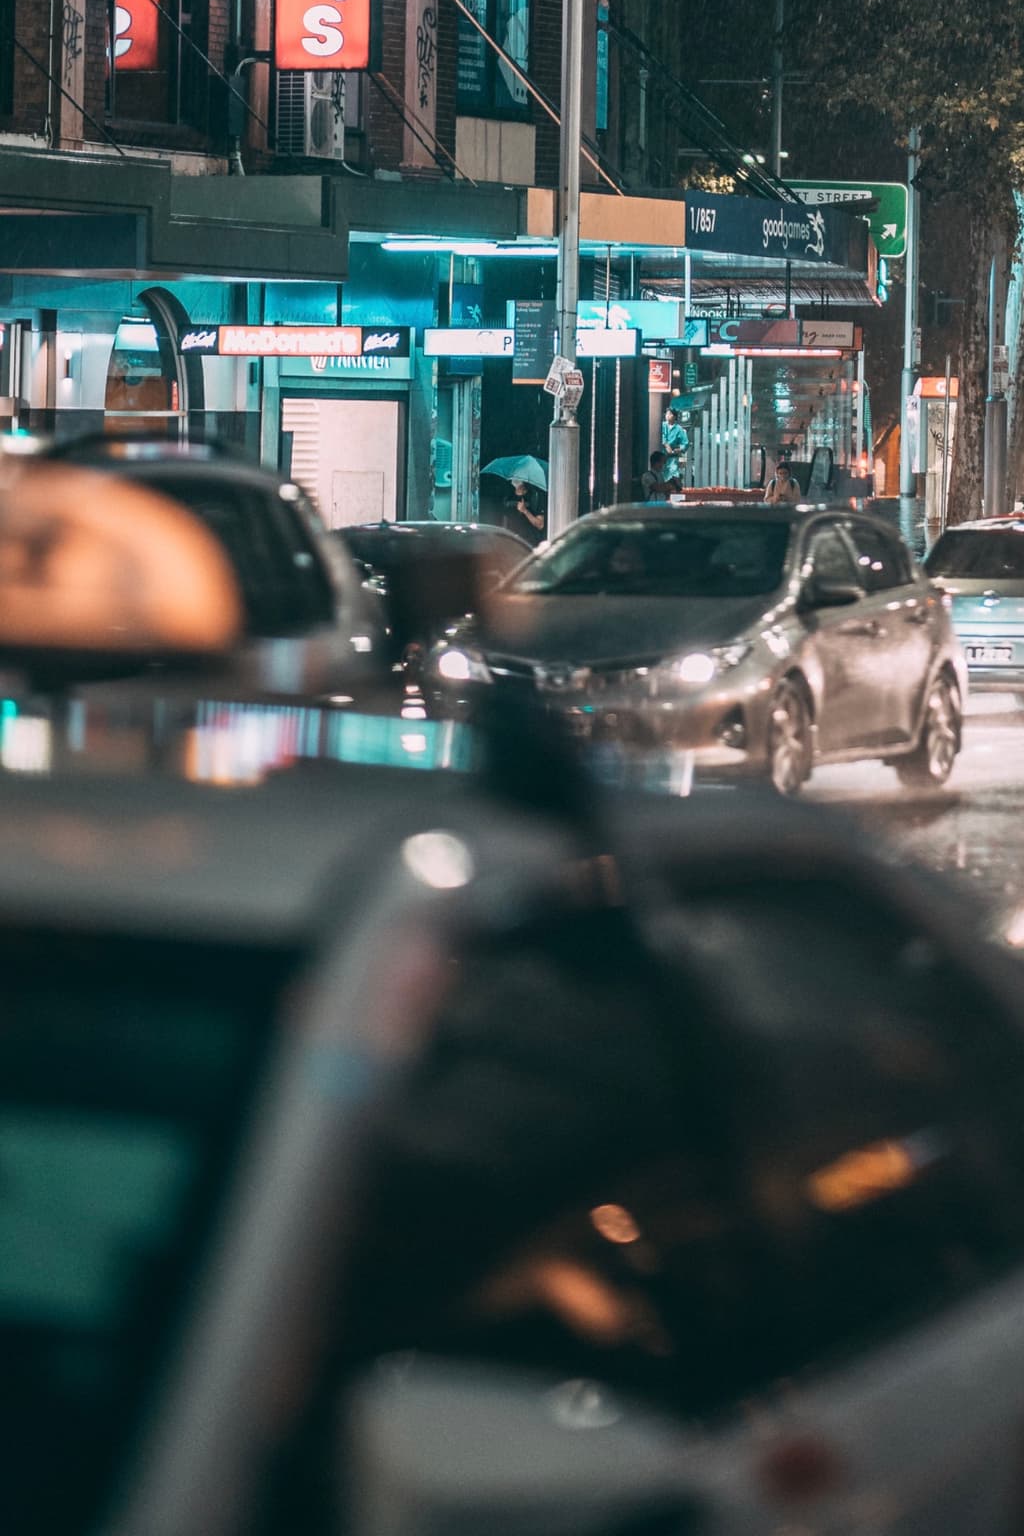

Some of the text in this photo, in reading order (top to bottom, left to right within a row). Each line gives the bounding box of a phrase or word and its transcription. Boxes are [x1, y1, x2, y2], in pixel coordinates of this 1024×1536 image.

[816, 192, 867, 202] STREET
[689, 207, 717, 234] 1/857
[223, 330, 358, 353] McDonald's
